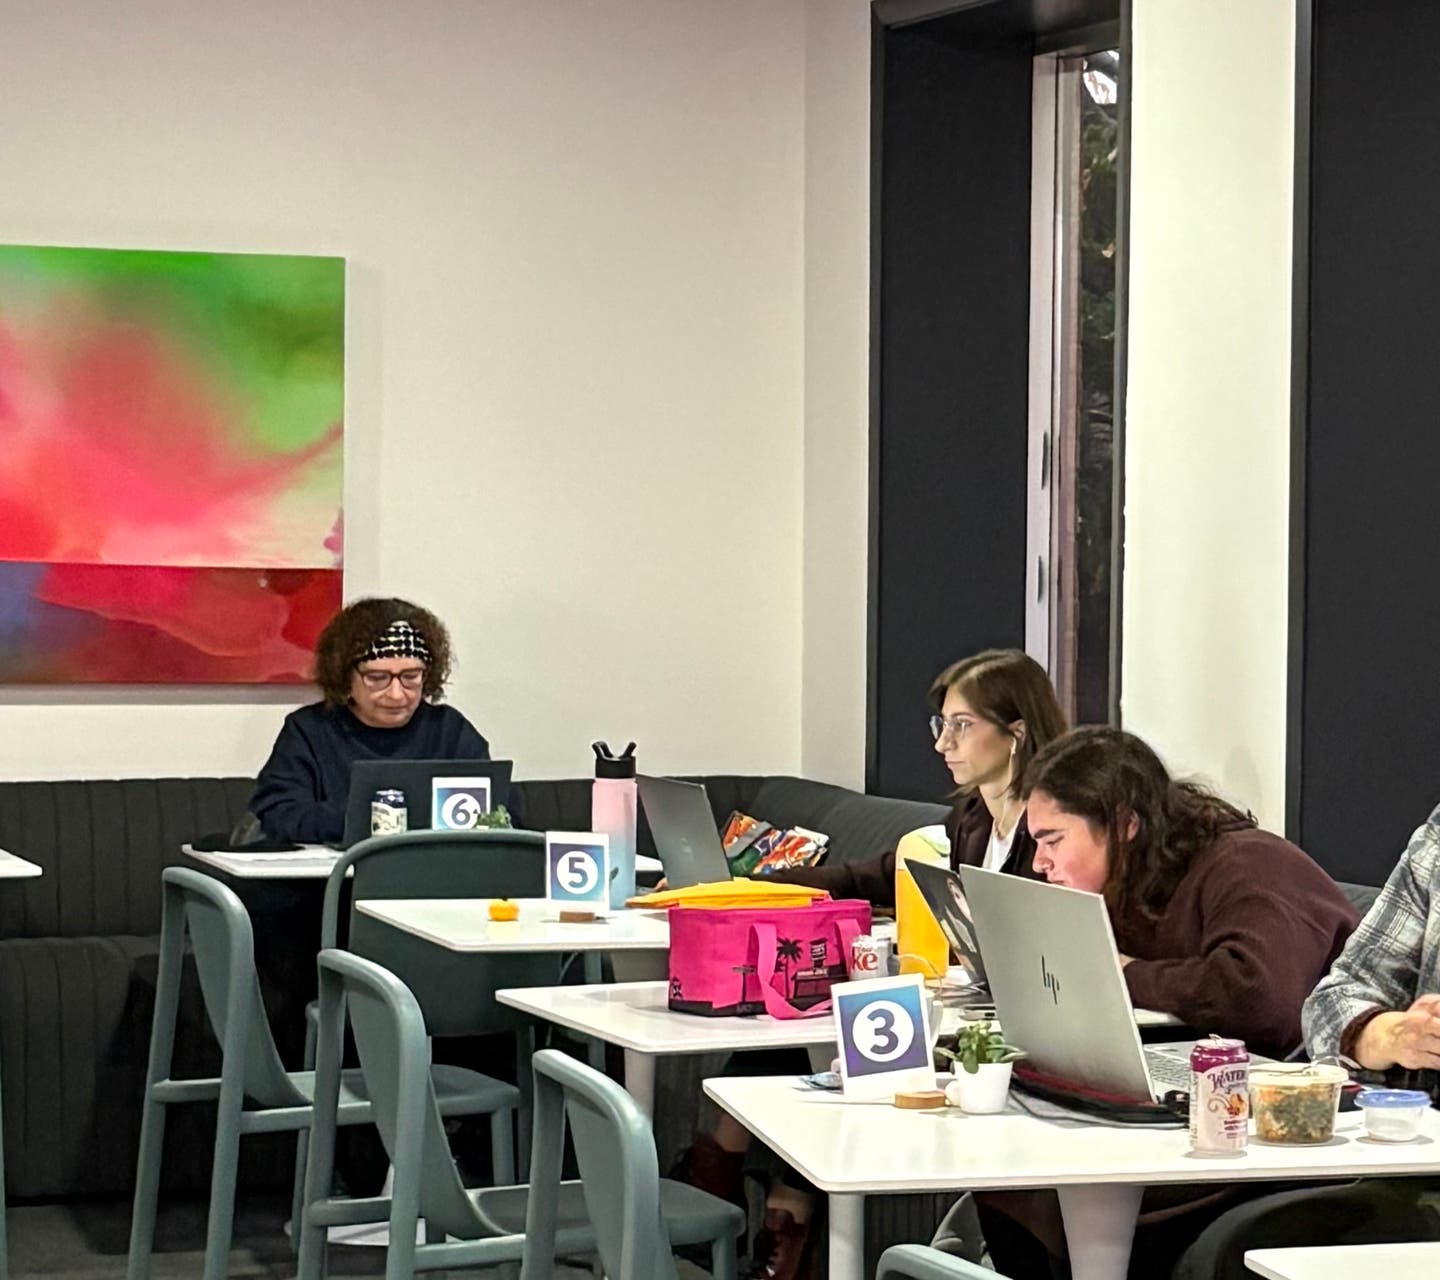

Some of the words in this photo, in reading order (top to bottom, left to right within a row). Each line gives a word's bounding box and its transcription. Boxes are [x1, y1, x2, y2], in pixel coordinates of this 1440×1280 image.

[451, 798, 471, 826] 6
[568, 856, 588, 889] 5
[852, 947, 878, 971] ke
[867, 1008, 899, 1055] 3
